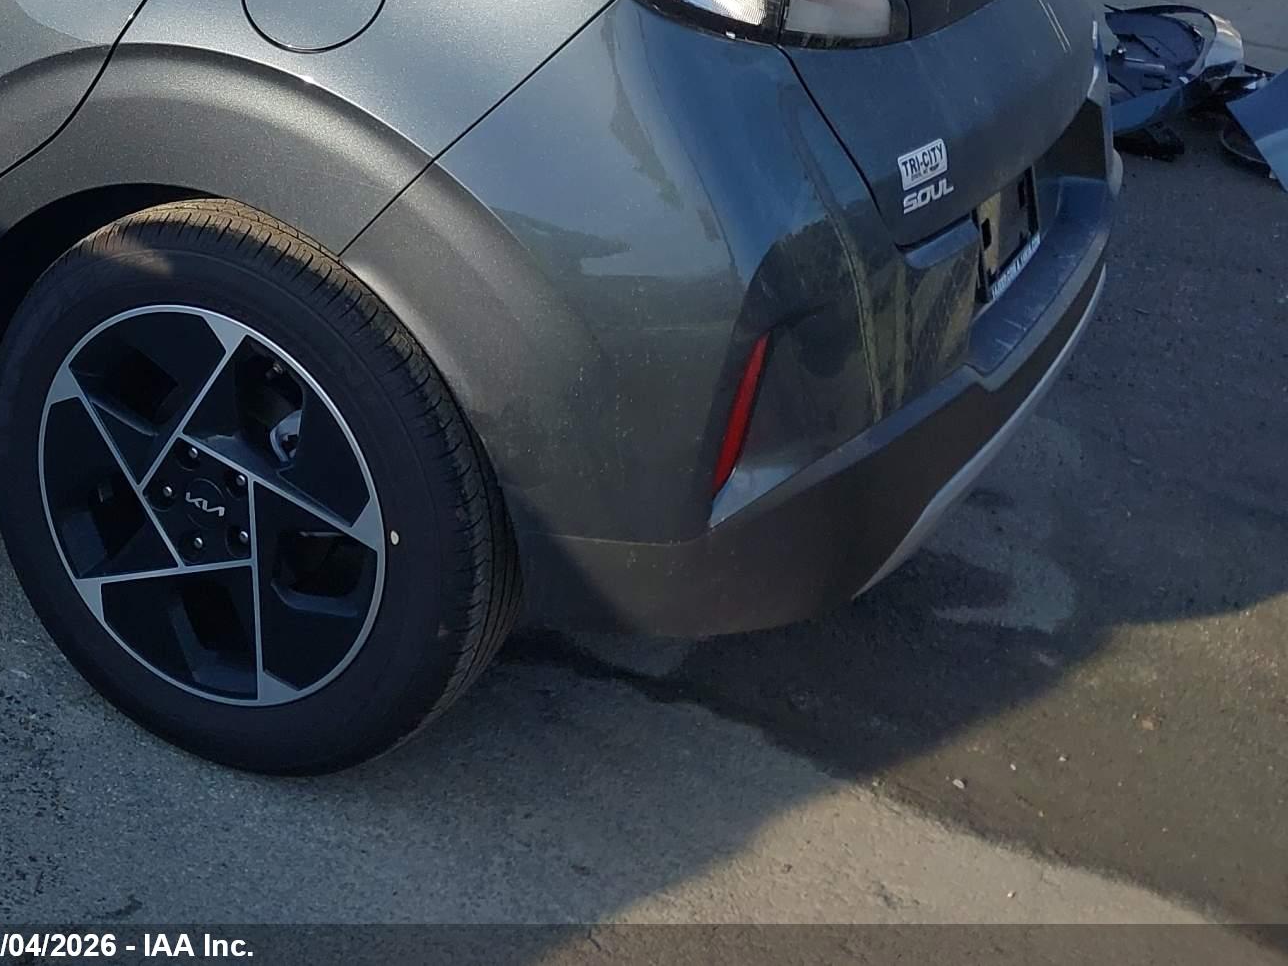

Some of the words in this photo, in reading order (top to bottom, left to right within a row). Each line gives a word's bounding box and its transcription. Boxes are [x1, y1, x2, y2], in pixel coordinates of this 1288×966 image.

[901, 143, 944, 177] TRI-CITY
[903, 178, 955, 215] SOUL
[185, 490, 225, 517] KIA
